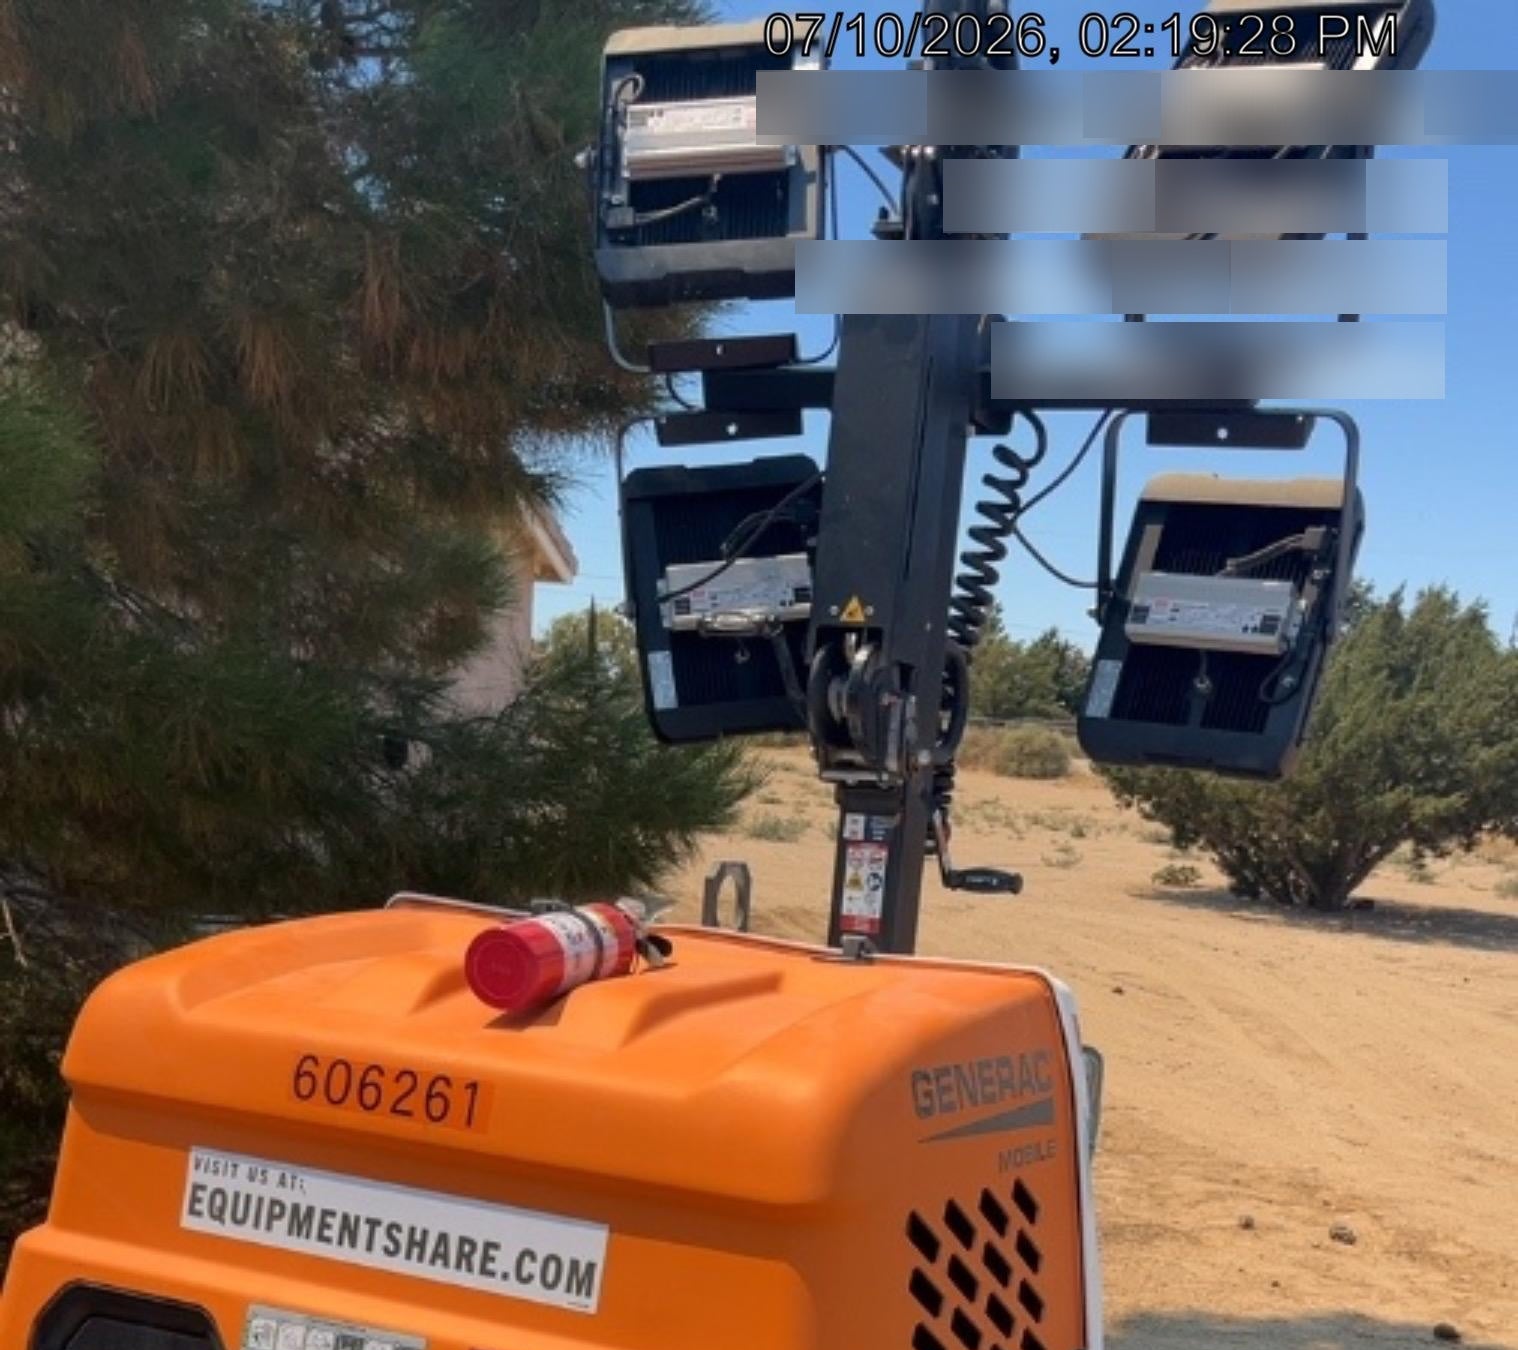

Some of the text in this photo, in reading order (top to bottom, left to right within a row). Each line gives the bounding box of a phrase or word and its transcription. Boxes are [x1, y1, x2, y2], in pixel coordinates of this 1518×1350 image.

[292, 1054, 480, 1129] 606261
[912, 1050, 1052, 1119] GENERAC
[194, 1156, 239, 1178] VISIT
[248, 1166, 268, 1185] US
[998, 1140, 1057, 1173] MOBILE
[188, 1183, 597, 1299] EQUIPMENTSHARE.COM
